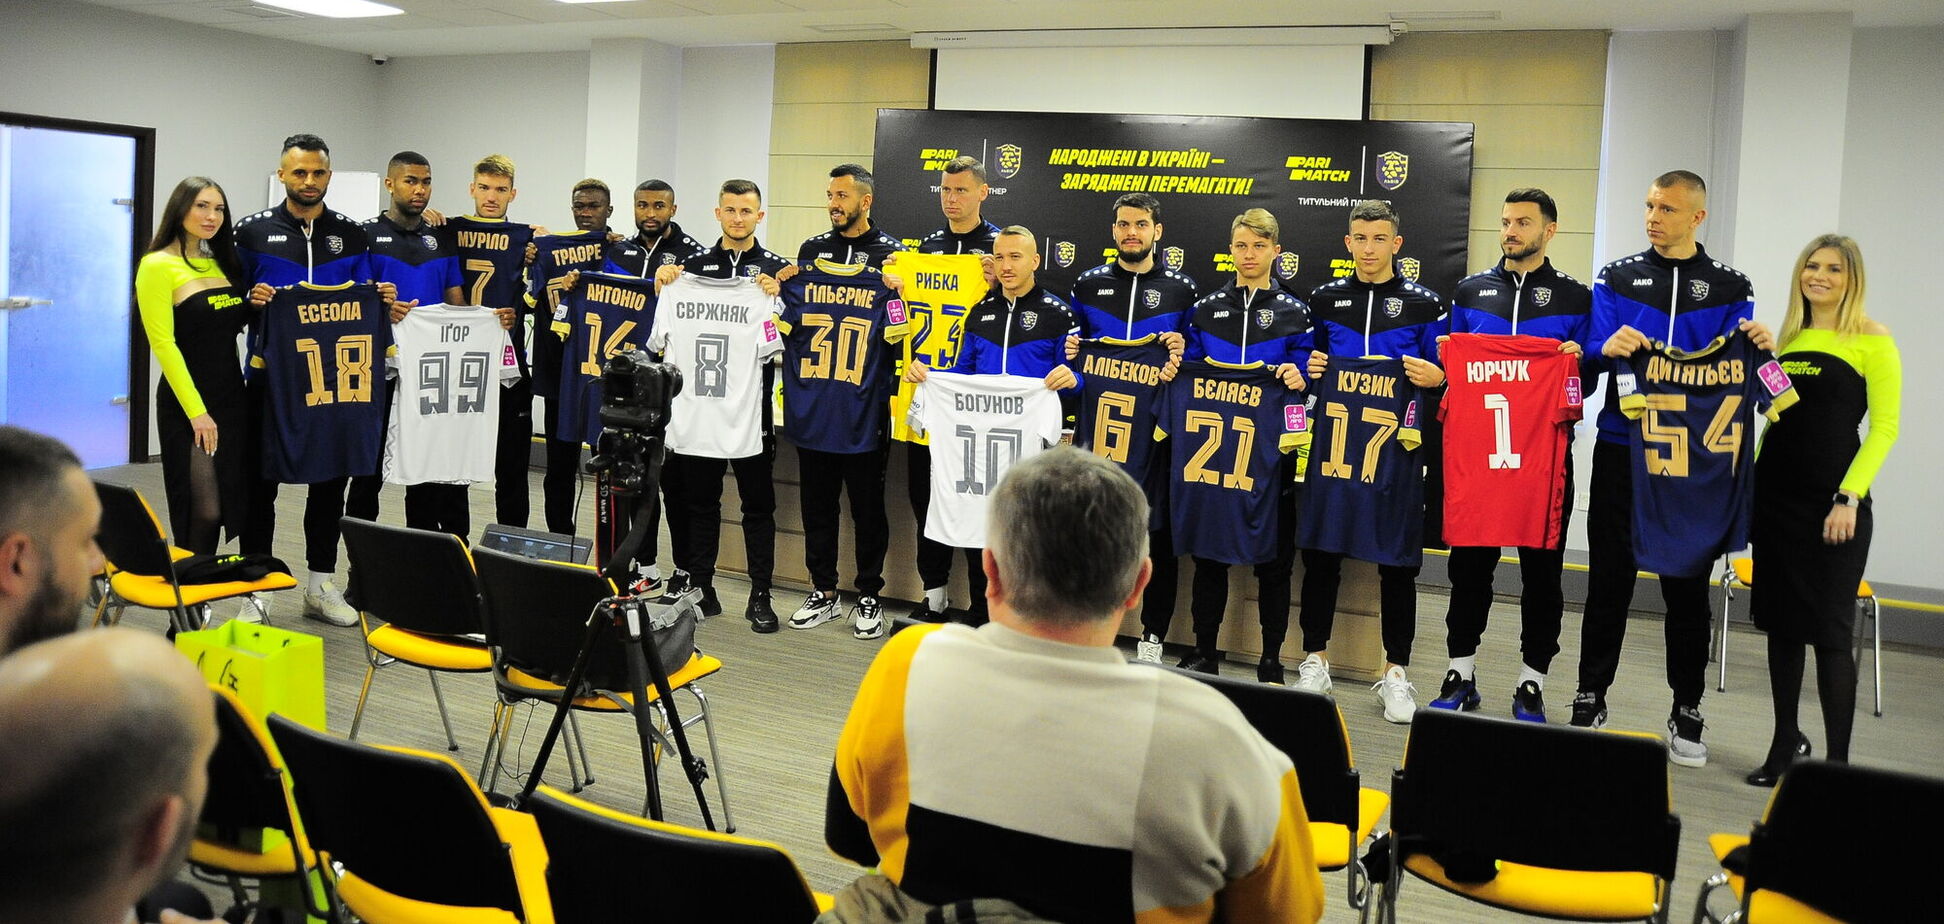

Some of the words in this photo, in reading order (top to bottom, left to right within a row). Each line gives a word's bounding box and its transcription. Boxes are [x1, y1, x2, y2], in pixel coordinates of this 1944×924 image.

[1048, 148, 1133, 167] НАРОДЖЕНІ
[1136, 150, 1150, 167] В
[1149, 148, 1211, 168] УКРАЇНІ
[1286, 156, 1332, 169] PARI
[1060, 173, 1149, 192] ЗАРЯДЖЕНІ
[1148, 175, 1254, 195] ПЕРЕМАГАТИ!
[1290, 169, 1351, 182] MATCH
[988, 187, 1007, 195] ТНЕР
[1298, 196, 1350, 207] ТИТУЛЬНИЙ
[457, 231, 510, 251] МУРІЛО
[551, 243, 603, 267] ТРАОРЕ
[466, 259, 495, 306] 7
[916, 272, 959, 291] РИБКА
[1097, 288, 1115, 296] JAKO
[1632, 278, 1653, 286] JAKO
[586, 283, 647, 311] АНТОНІО
[297, 301, 362, 324] ЕСЕОЛА
[676, 301, 749, 324] СВРЖНЯК
[1213, 310, 1230, 318] JAKO
[440, 323, 470, 343] ІҐОР
[800, 313, 872, 386] 30
[296, 334, 373, 407] 18
[695, 333, 730, 398] 8
[1083, 354, 1161, 386] АЛІБЕКОВ
[1466, 359, 1531, 383] ЮРЧУК
[1645, 355, 1745, 386] ДИТЯТЬЄВ
[418, 351, 491, 416] 99
[1193, 377, 1263, 407] БЄЛЯЄВ
[1337, 370, 1396, 399] КУЗИК
[954, 393, 1024, 415] БОГУНОВ
[1093, 390, 1136, 463] 6
[1484, 393, 1521, 470] 1
[1642, 393, 1743, 478] 54
[1183, 409, 1256, 492] 21
[1321, 402, 1399, 484] 17
[955, 424, 1022, 496] 10
